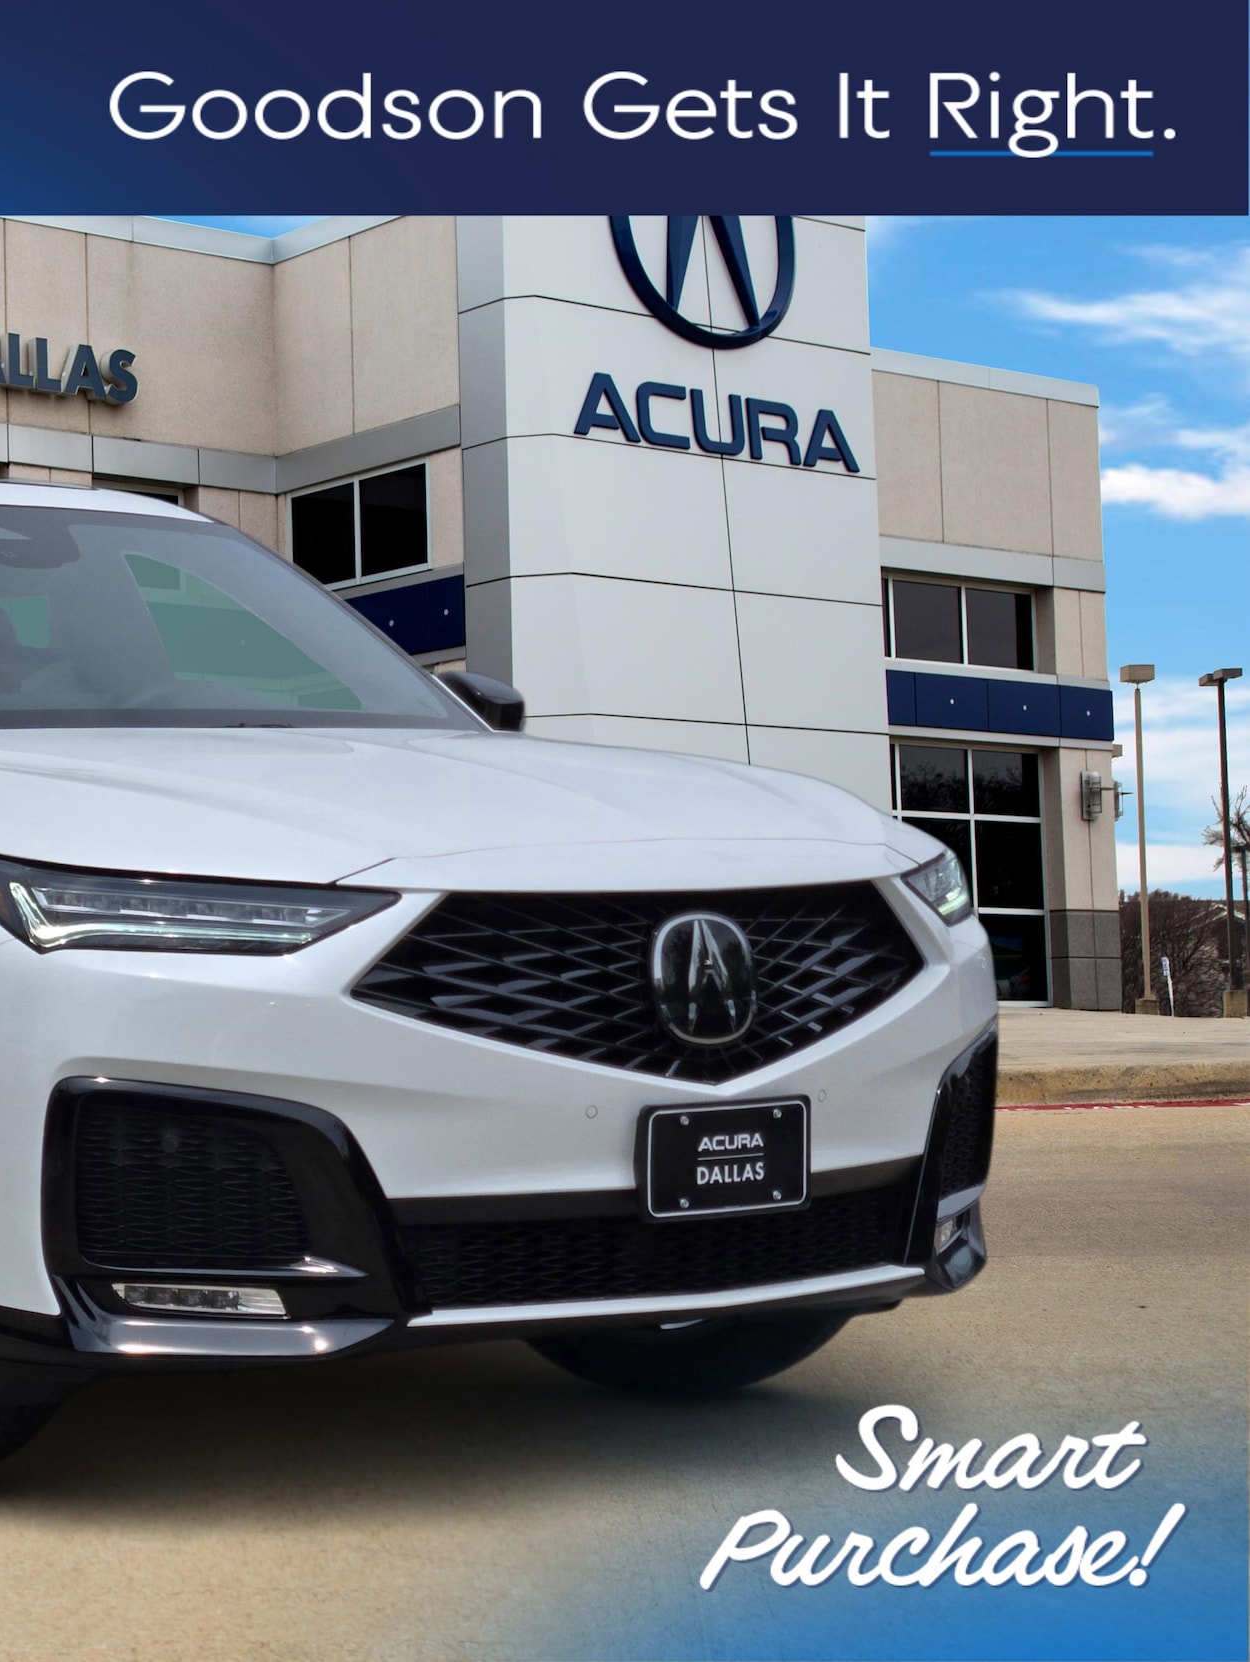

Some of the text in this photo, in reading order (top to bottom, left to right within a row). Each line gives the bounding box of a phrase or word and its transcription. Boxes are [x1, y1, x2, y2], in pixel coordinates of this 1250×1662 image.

[573, 371, 860, 473] ACURA
[698, 1132, 764, 1152] ACURA
[696, 1161, 765, 1185] DALLAS
